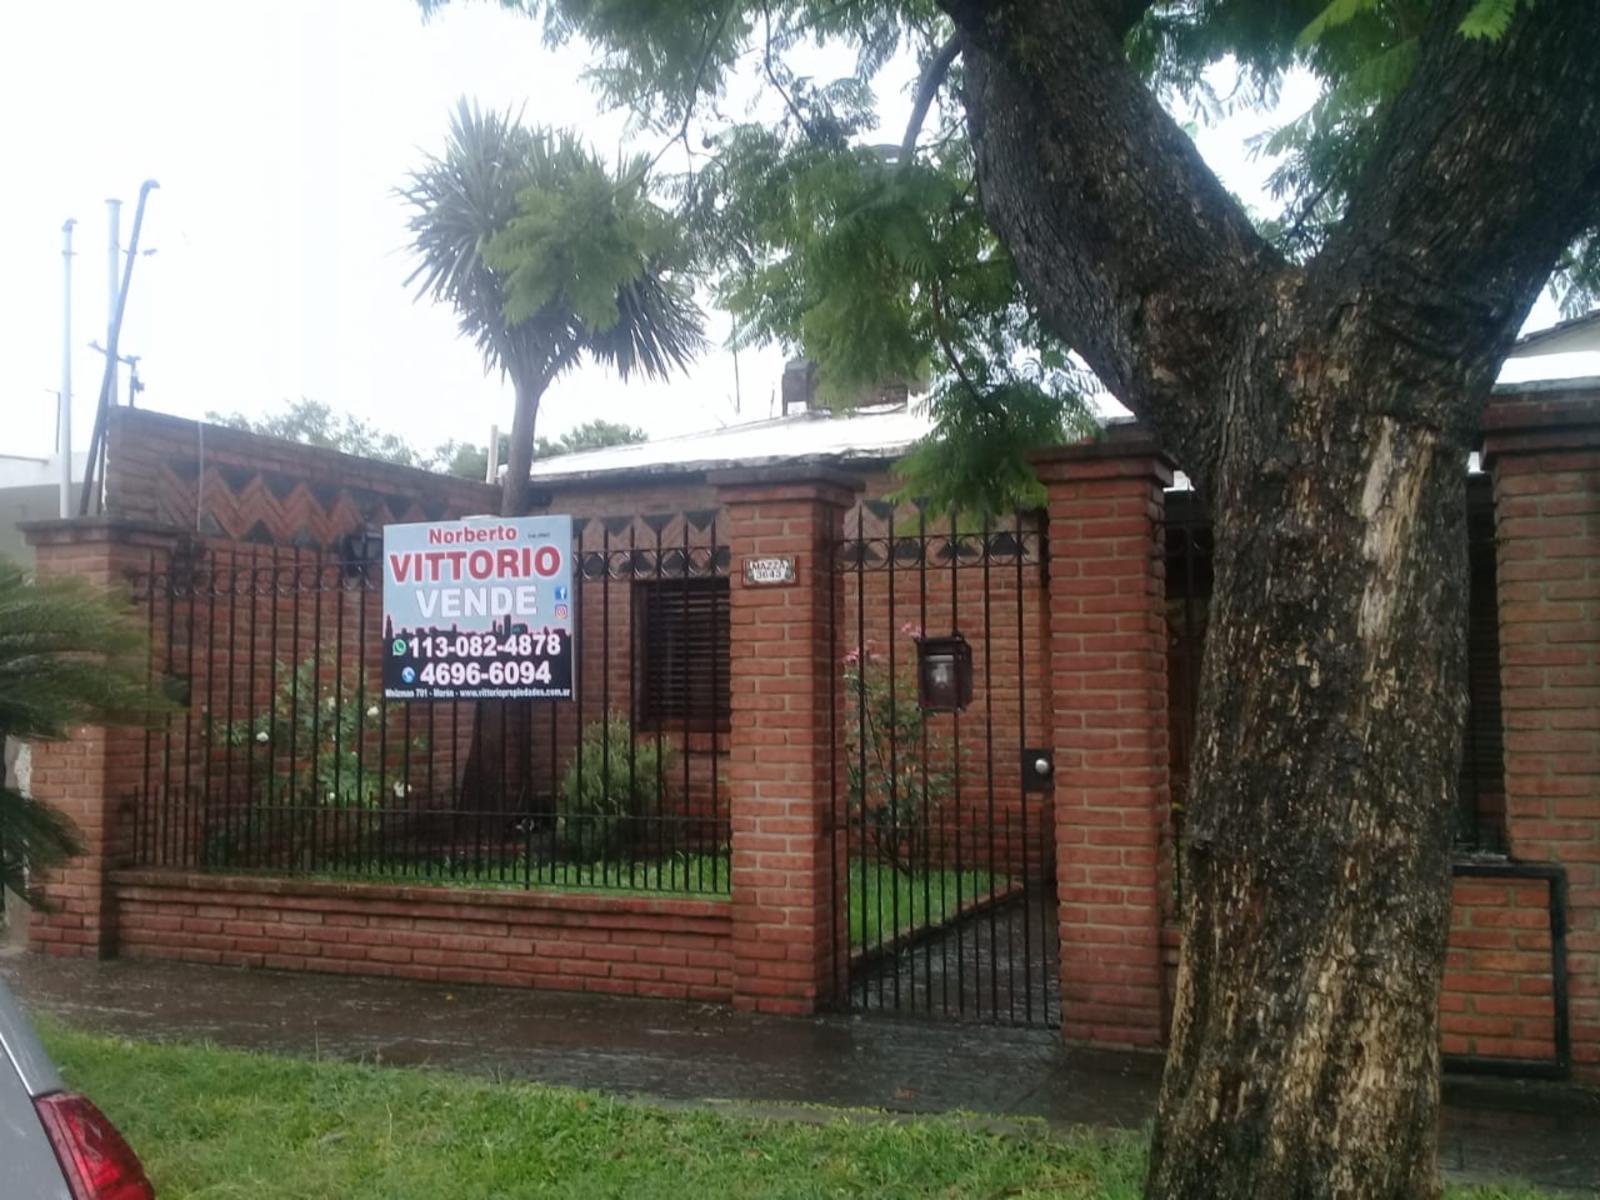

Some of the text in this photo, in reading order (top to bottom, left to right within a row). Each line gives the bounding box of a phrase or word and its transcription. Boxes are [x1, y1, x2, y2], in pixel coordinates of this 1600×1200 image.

[428, 525, 518, 545] Norberto
[389, 545, 561, 583] VITTORIO
[415, 585, 538, 619] VENDE
[409, 634, 561, 658] 113-082-4878
[419, 661, 552, 686] 4696-6094
